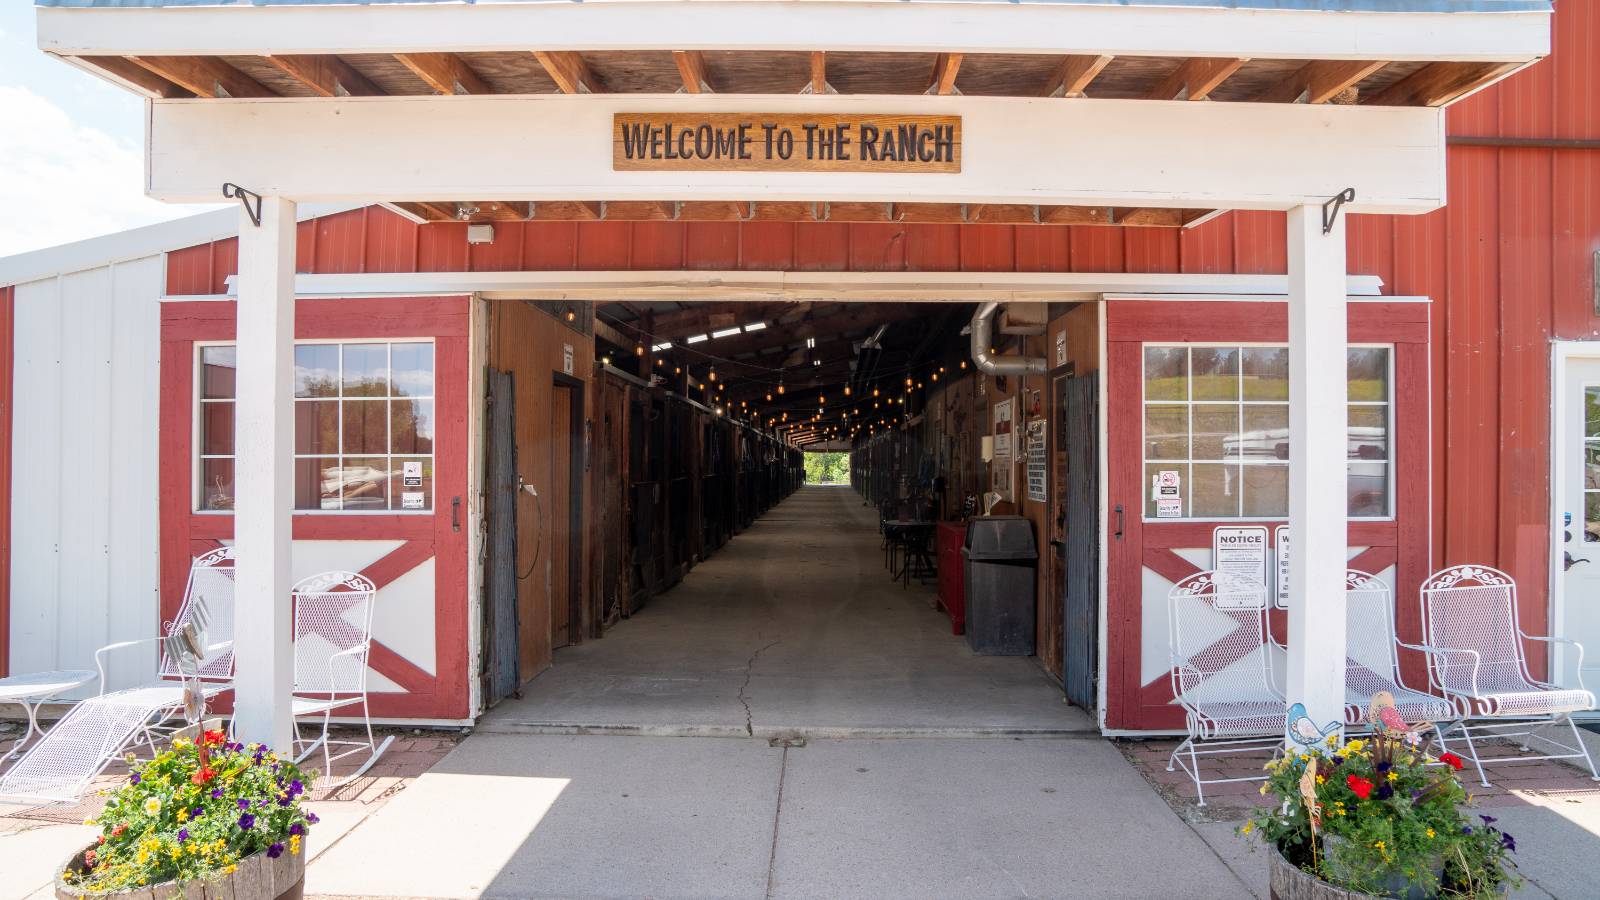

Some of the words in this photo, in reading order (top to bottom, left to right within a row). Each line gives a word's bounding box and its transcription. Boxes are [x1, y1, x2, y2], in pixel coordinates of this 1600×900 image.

[621, 122, 753, 160] WELCOME
[761, 122, 793, 160] TO
[802, 123, 850, 161] THE
[860, 123, 955, 163] RANCH
[1220, 535, 1262, 544] NOTICE
